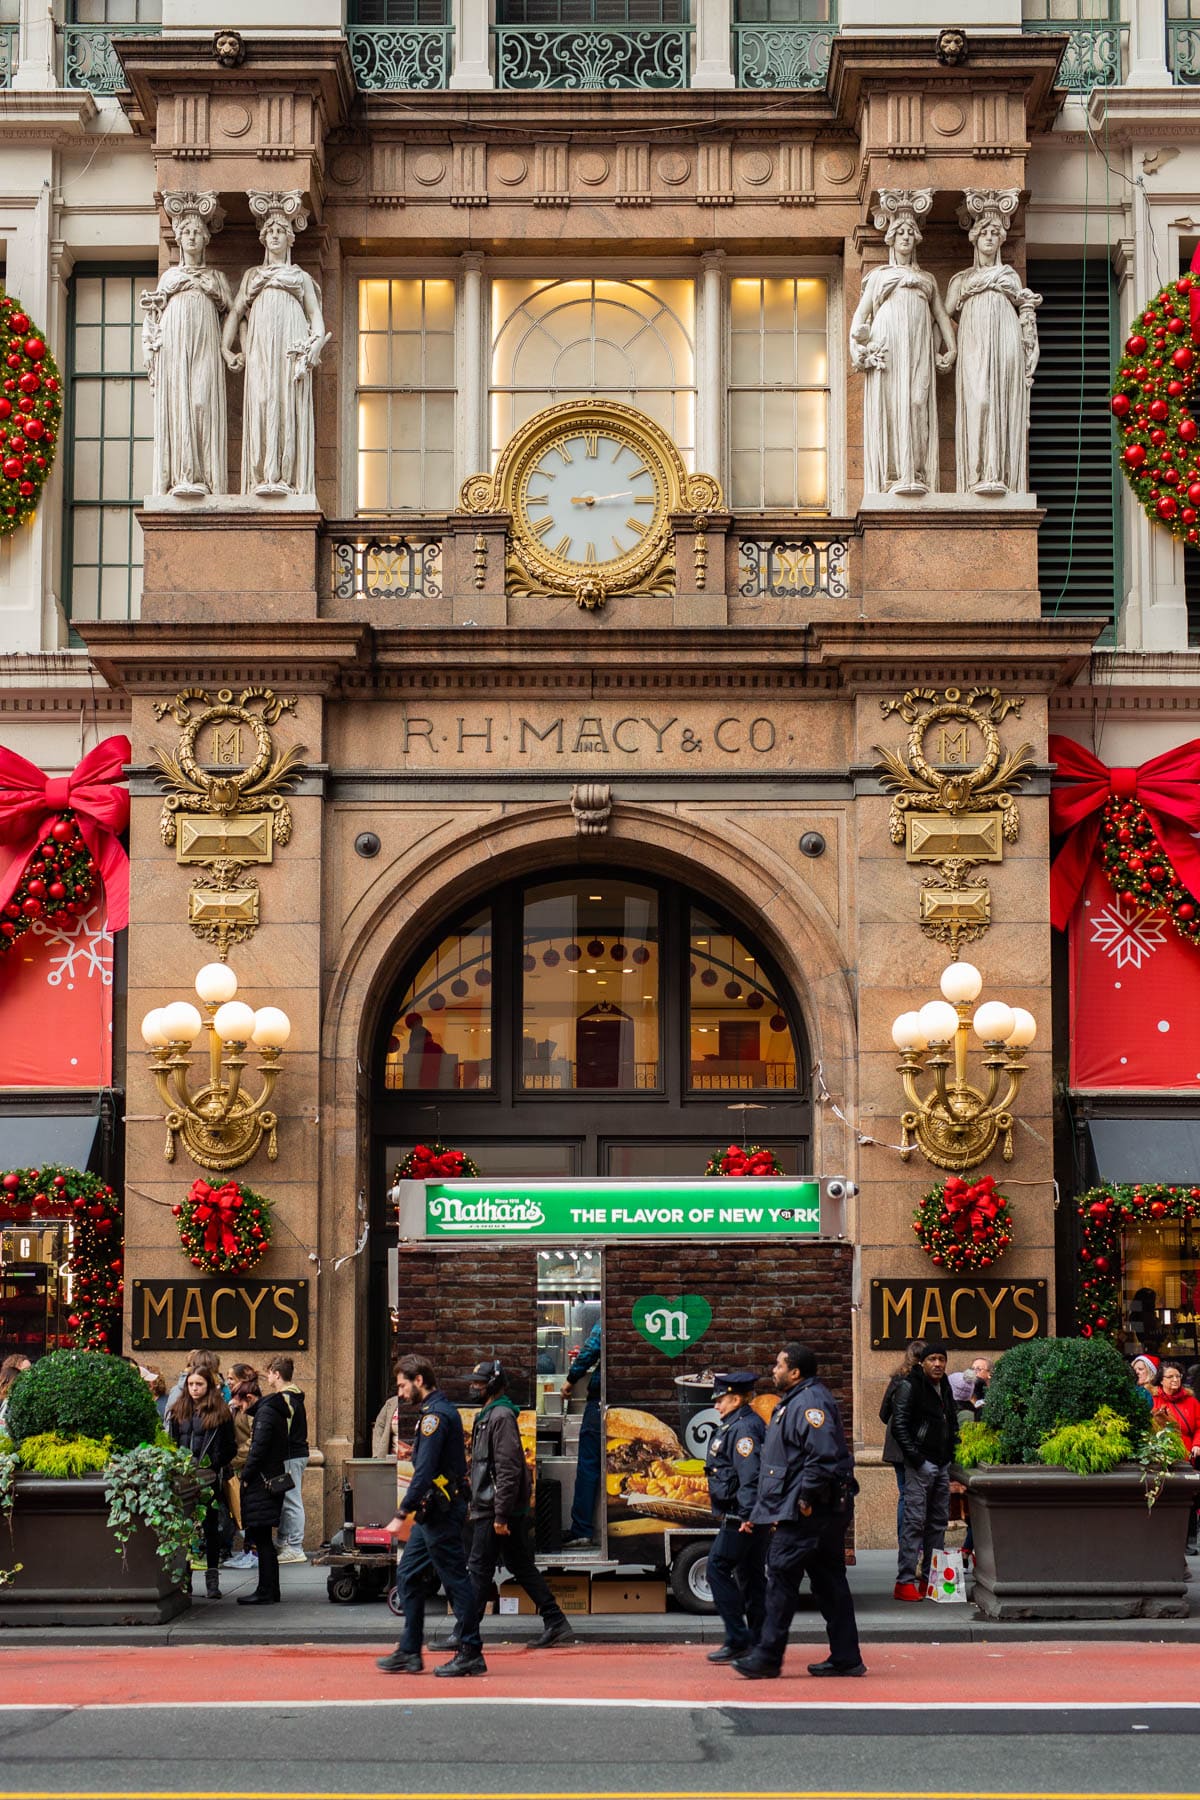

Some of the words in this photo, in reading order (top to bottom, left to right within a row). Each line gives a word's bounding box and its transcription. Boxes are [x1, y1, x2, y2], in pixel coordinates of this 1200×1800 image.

[428, 1197, 546, 1222] Nathan's
[570, 1208, 607, 1223] THE
[611, 1208, 684, 1223] FLAVOR
[688, 1208, 715, 1223] OF
[719, 1208, 764, 1223] NEW
[142, 1285, 299, 1339] MACY'S
[882, 1285, 1039, 1339] MACY'S
